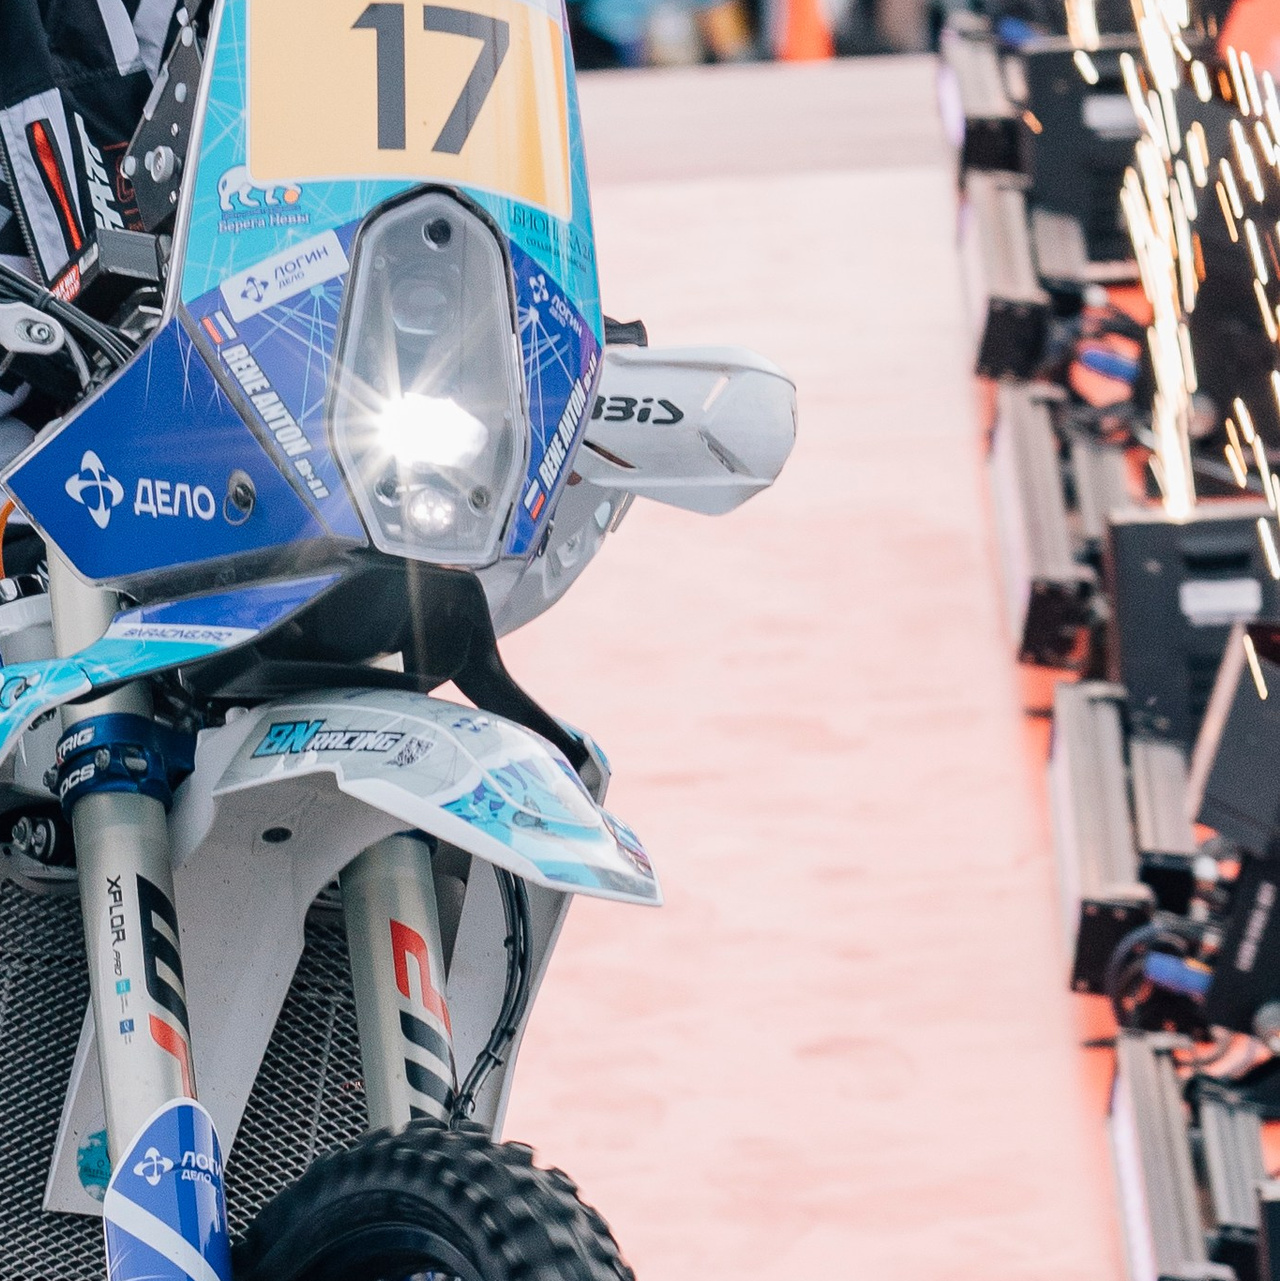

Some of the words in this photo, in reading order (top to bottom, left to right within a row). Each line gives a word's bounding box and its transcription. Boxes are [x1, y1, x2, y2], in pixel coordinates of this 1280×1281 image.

[351, 2, 510, 155] 17
[218, 219, 267, 235] Берега
[274, 245, 329, 280] ЛОГИН
[222, 343, 270, 396] RENE
[250, 391, 312, 458] ANTON
[539, 432, 567, 491] RENE
[558, 377, 586, 450] ANTON
[134, 478, 216, 521] ДЕЛО
[252, 719, 326, 758] BN
[307, 731, 404, 753] RACING
[106, 875, 126, 947] XPLOR
[181, 1169, 212, 1184] ДЕЛО
